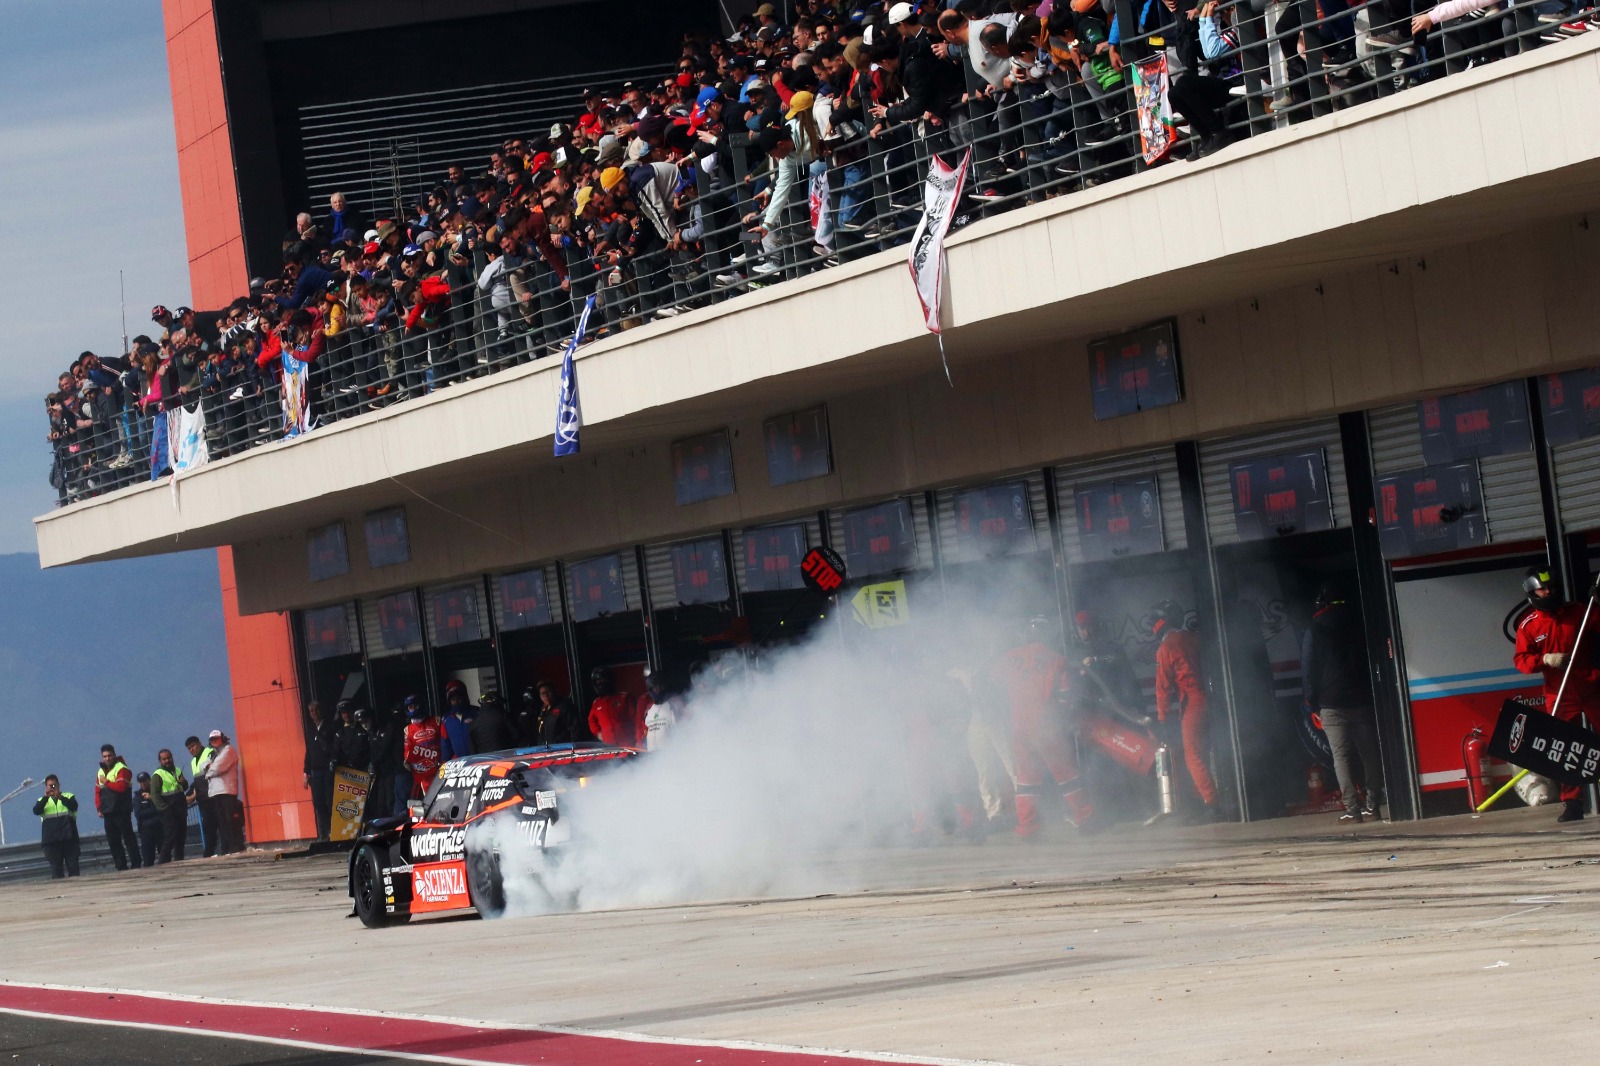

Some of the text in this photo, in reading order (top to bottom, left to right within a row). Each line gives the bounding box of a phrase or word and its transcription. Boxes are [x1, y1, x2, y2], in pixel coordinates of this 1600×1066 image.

[801, 550, 843, 591] STOP
[876, 590, 899, 619] 137
[412, 745, 438, 760] STOP
[1532, 736, 1547, 752] 5
[1548, 739, 1565, 763] 25
[1563, 741, 1585, 772] 172
[1581, 748, 1600, 778] 133
[338, 783, 367, 797] STOP
[480, 788, 506, 801] AUTOS
[424, 868, 466, 896] SCIENZA
[426, 895, 449, 903] FARMACIA
